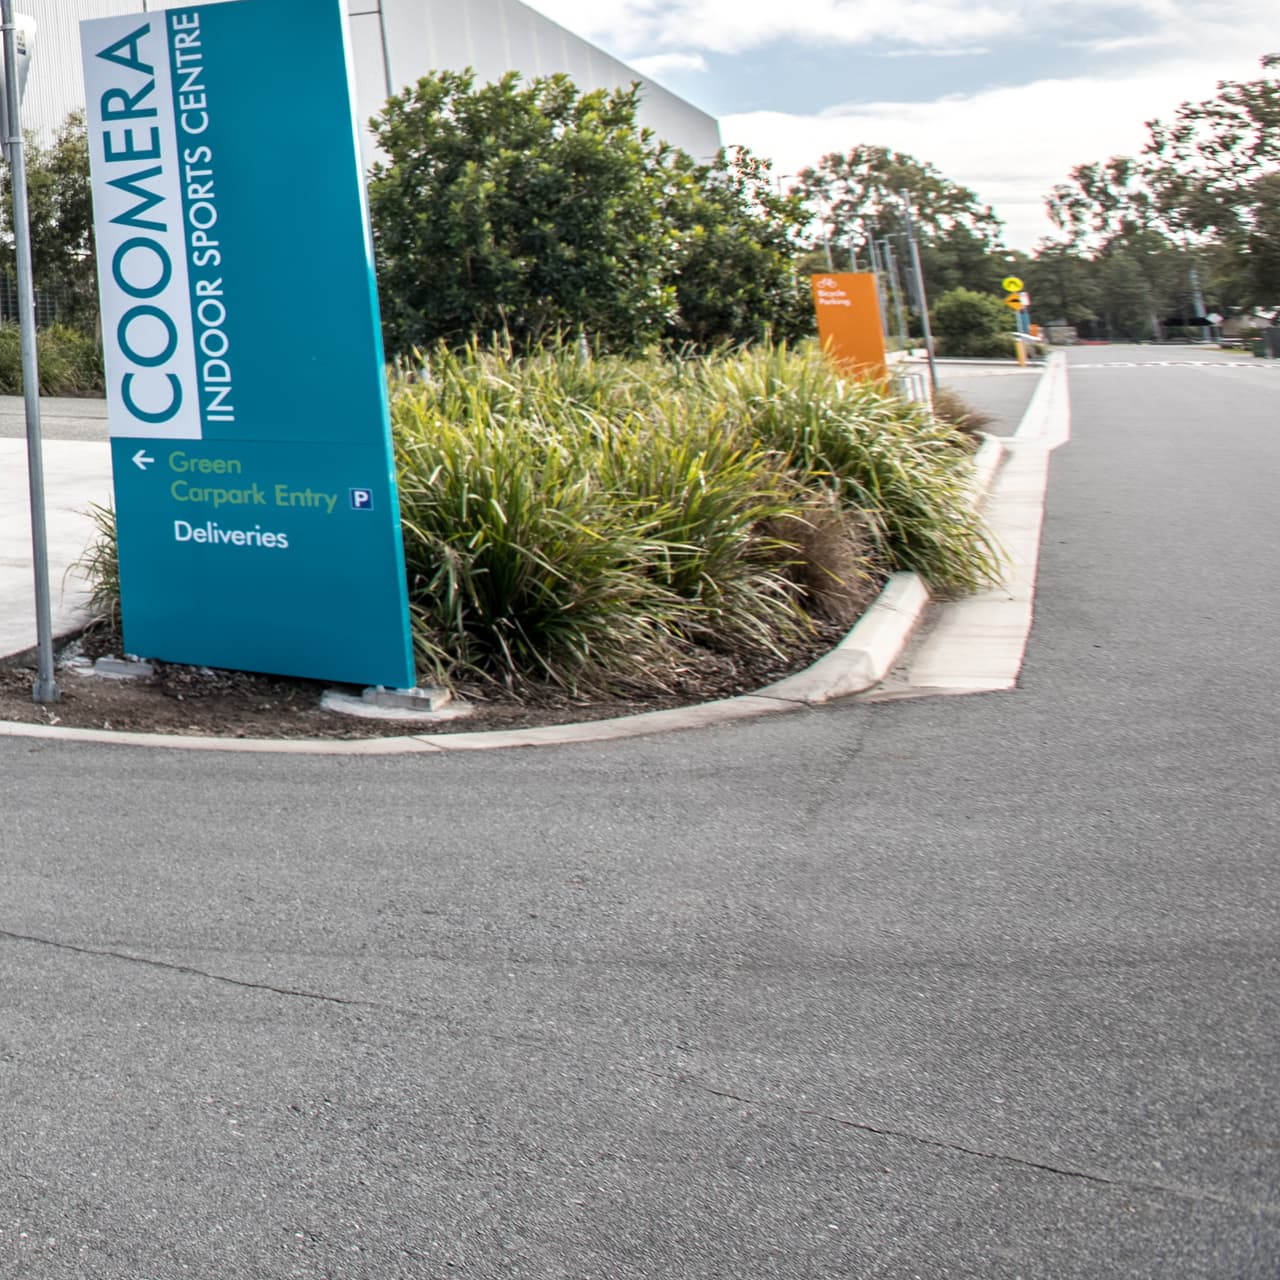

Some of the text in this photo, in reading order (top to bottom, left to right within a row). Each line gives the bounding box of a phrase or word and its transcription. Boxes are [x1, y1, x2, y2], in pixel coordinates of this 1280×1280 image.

[95, 22, 183, 424] COOMERA
[172, 12, 235, 422] INDOOR SPORTS CENTRE
[168, 451, 241, 474] Green
[171, 480, 368, 513] Carpark Entry P
[173, 520, 288, 548] Deliveries
